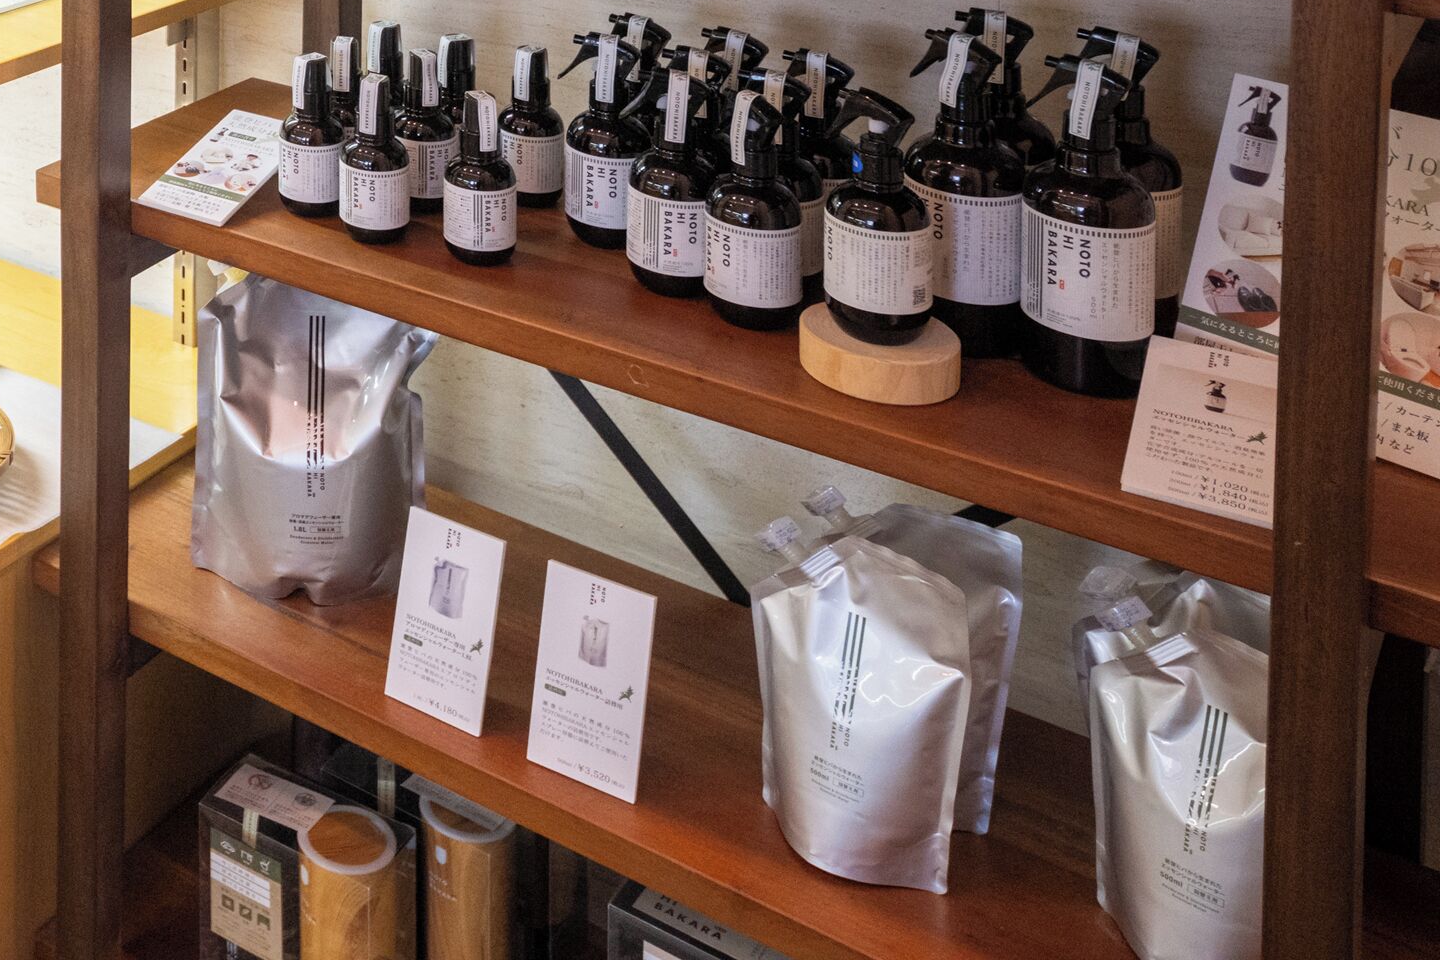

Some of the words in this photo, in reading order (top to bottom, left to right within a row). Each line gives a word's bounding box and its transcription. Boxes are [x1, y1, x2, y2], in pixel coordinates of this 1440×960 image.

[361, 178, 367, 187] HI
[585, 164, 594, 207] BAKARA
[597, 167, 605, 178] HI
[608, 168, 618, 199] NOTO
[493, 199, 499, 208] HI
[676, 212, 685, 224] HI
[664, 210, 672, 256] BAKARA
[688, 212, 698, 245] NOTO
[933, 202, 943, 240] NOTO
[712, 230, 720, 243] HI
[722, 234, 731, 268] NOTO
[1063, 234, 1074, 250] HI
[1047, 229, 1058, 286] BAKARA
[1079, 238, 1091, 279] NOTO
[1153, 408, 1234, 432] NOTOHIBAKARA
[546, 668, 603, 695] NOTOHIBAKARA
[1160, 871, 1183, 887] 500ml
[654, 903, 724, 940] BAKARA
